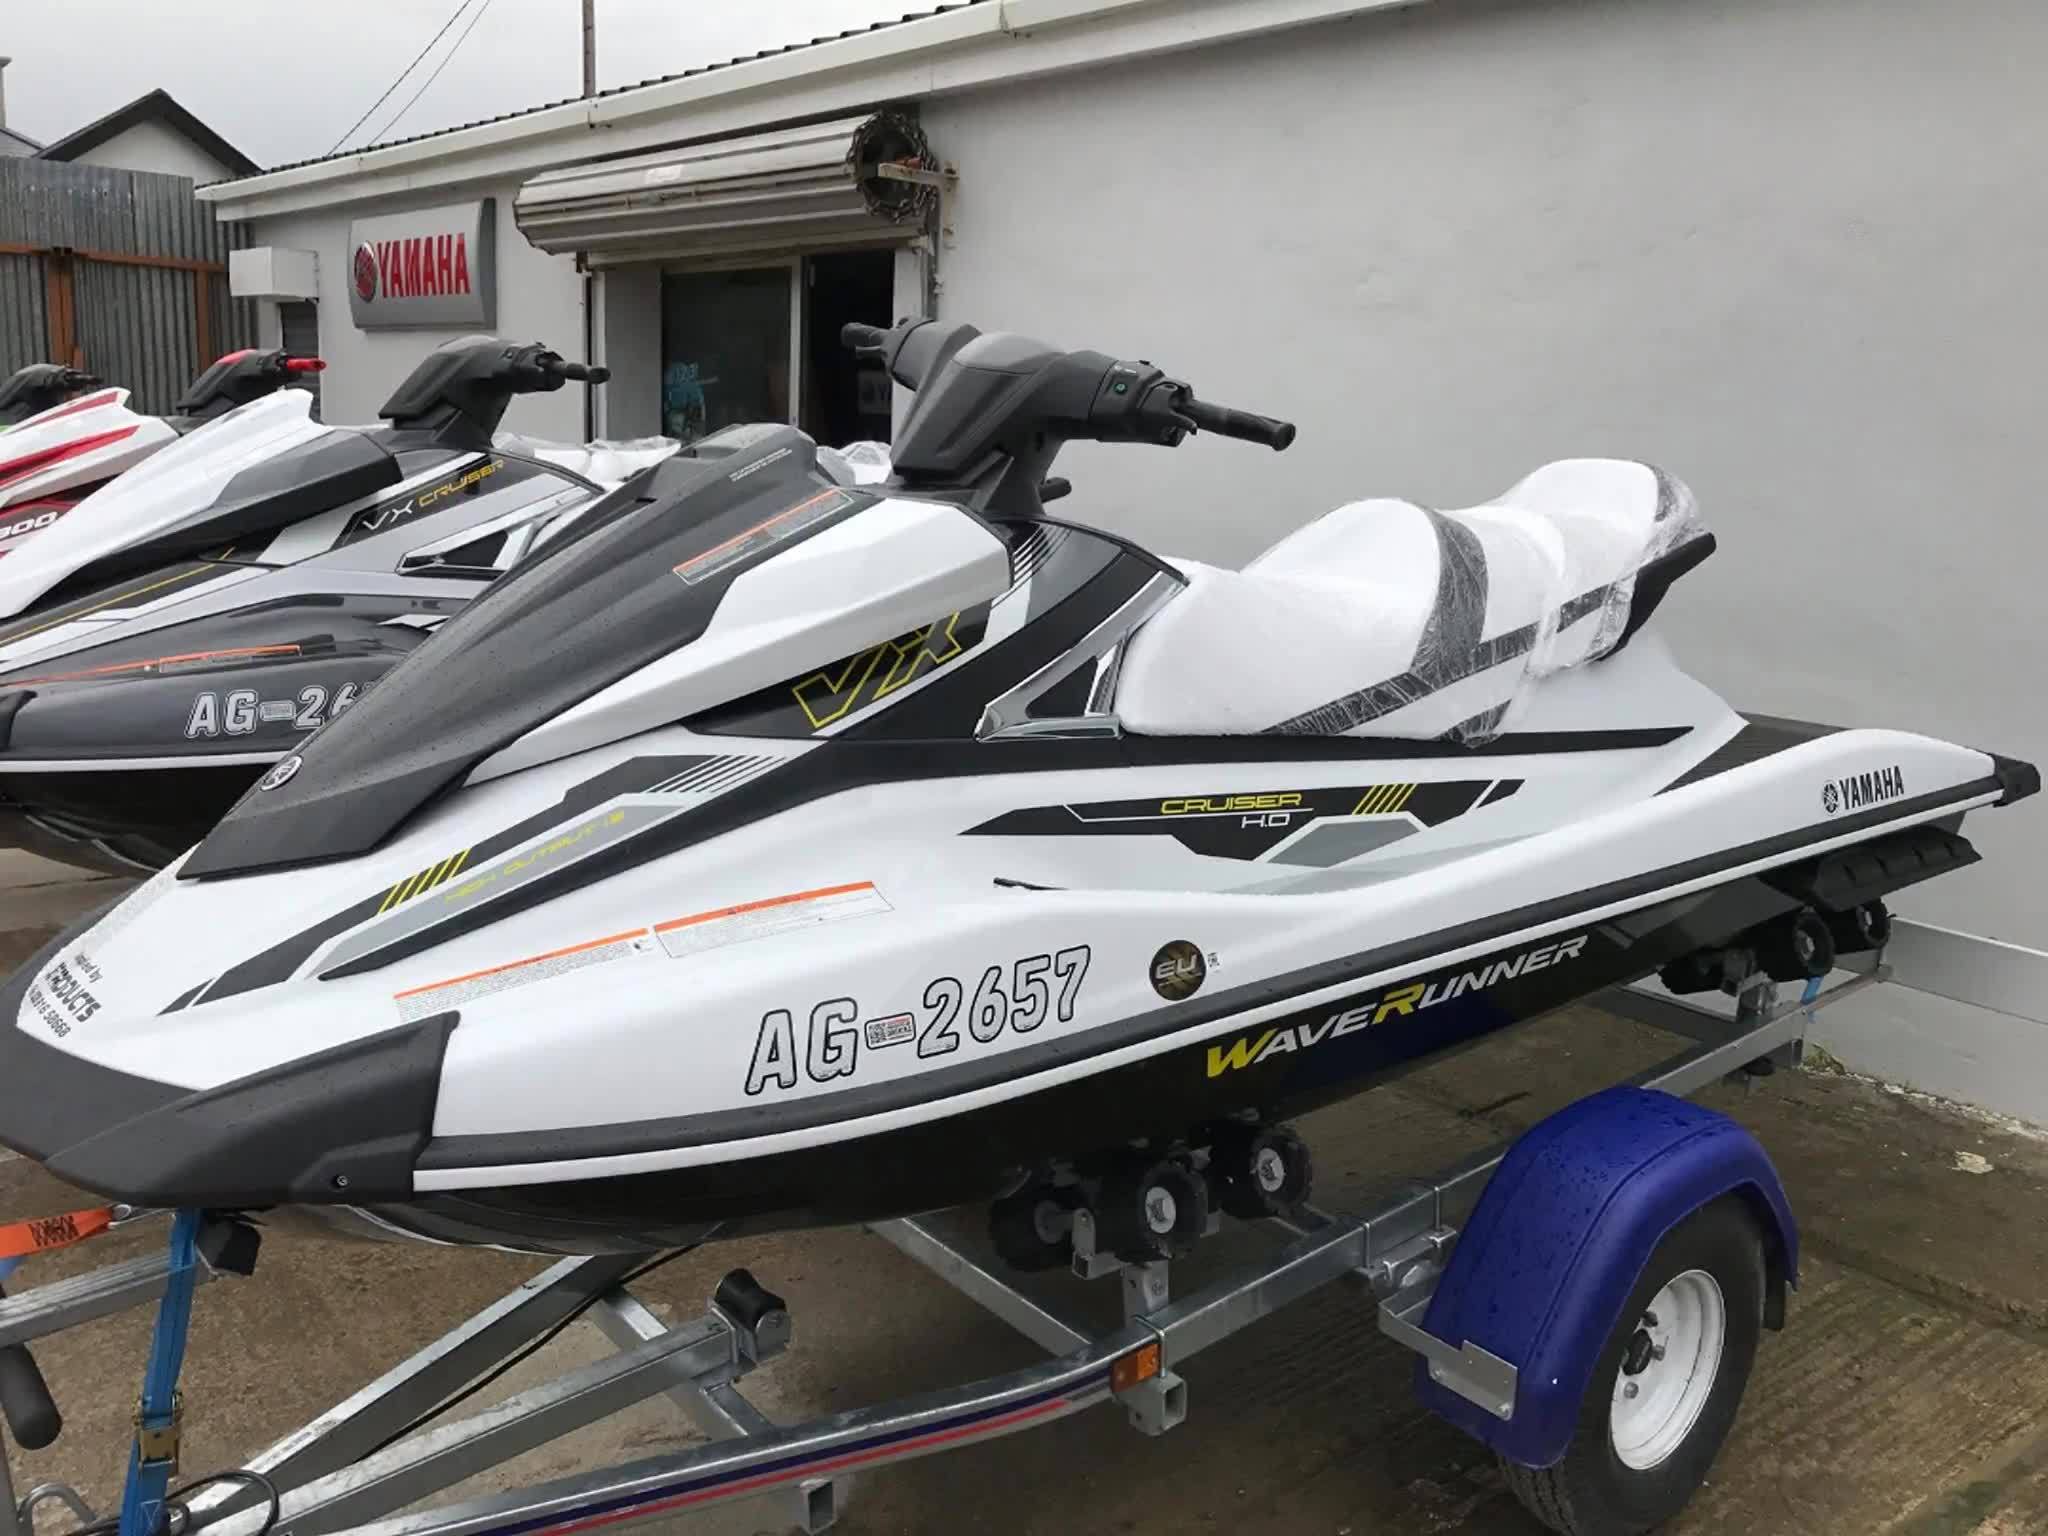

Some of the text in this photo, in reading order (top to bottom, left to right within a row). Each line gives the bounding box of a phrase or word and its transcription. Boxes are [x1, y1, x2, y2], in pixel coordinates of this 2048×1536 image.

[377, 232, 471, 298] YAMAHA
[363, 459, 504, 531] VX CRUISER
[1161, 793, 1302, 814] CRUISER
[1839, 765, 1904, 810] YAMAHA
